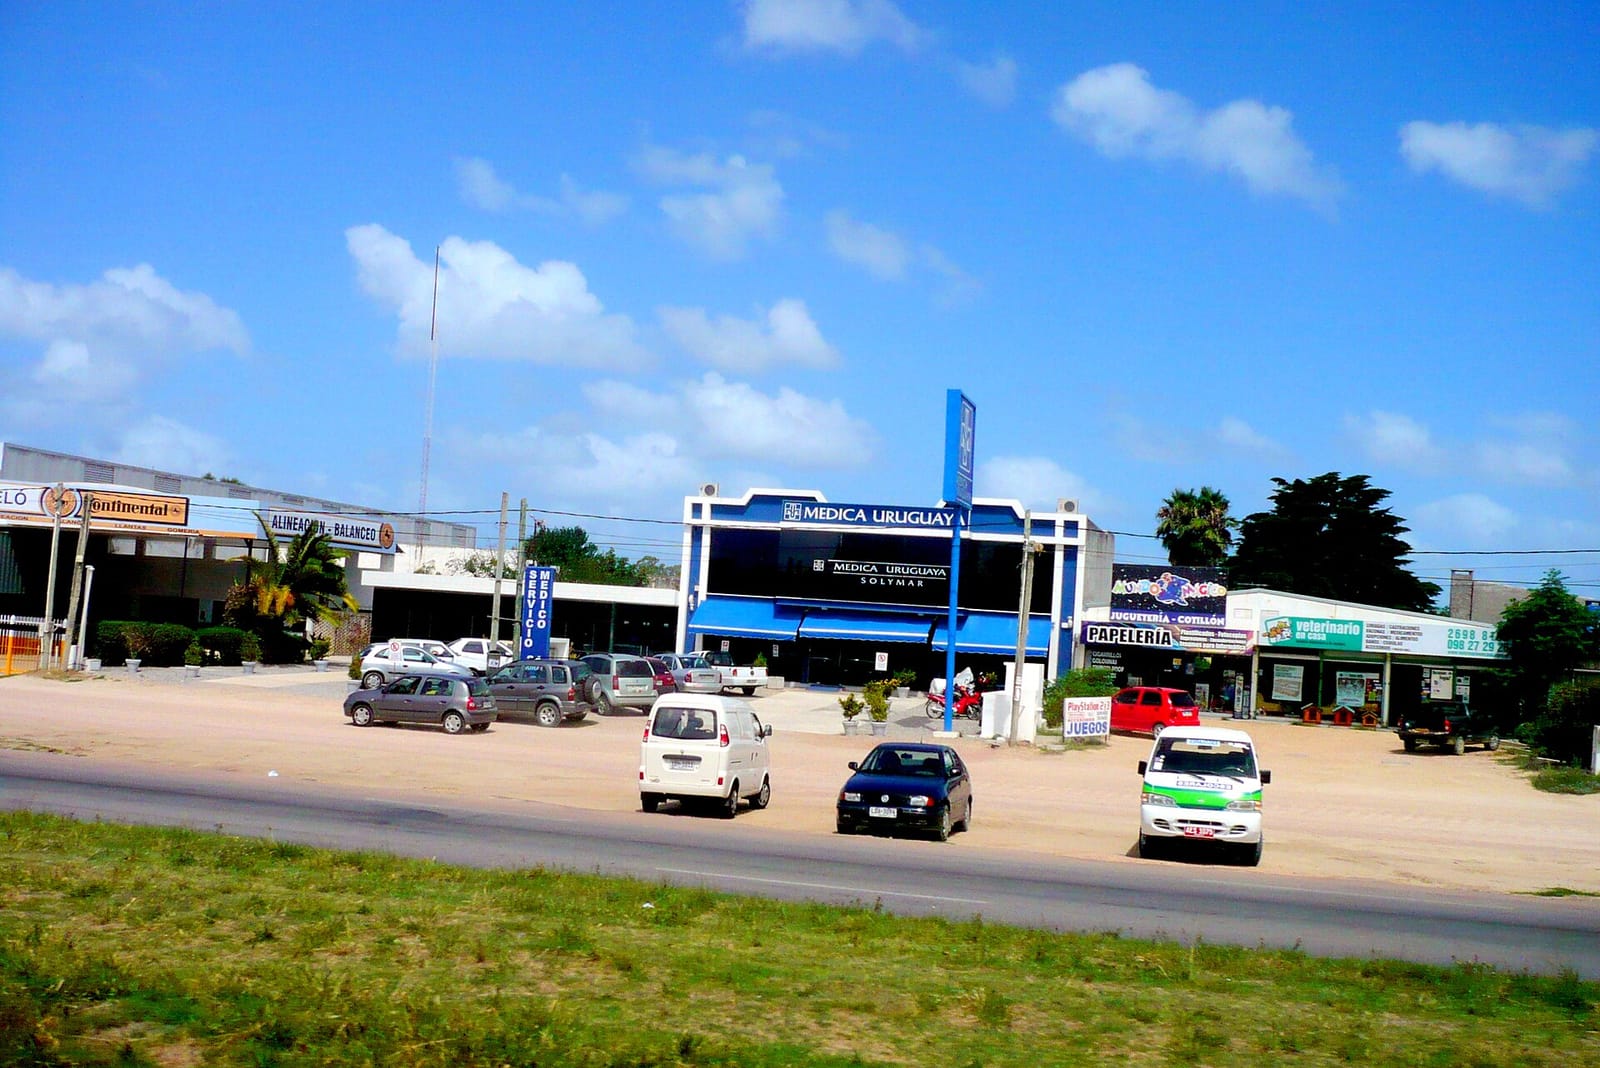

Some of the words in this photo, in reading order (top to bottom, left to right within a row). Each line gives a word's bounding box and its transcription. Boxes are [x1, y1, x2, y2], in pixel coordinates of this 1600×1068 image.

[803, 506, 867, 522] MEDICA
[334, 523, 377, 541] BALANCEO
[833, 562, 878, 573] MEDICA
[886, 566, 947, 577] URUGUAYA
[860, 576, 925, 587] SOLYMAR
[537, 570, 550, 629] MEDICO
[525, 570, 537, 647] SERVICIO
[1295, 620, 1361, 635] veterinario
[1448, 629, 1476, 640] 2698
[1088, 626, 1173, 647] PAPELERÍA
[1467, 641, 1479, 650] 27
[1482, 642, 1495, 652] 29
[1067, 721, 1108, 735] JUEGOS
